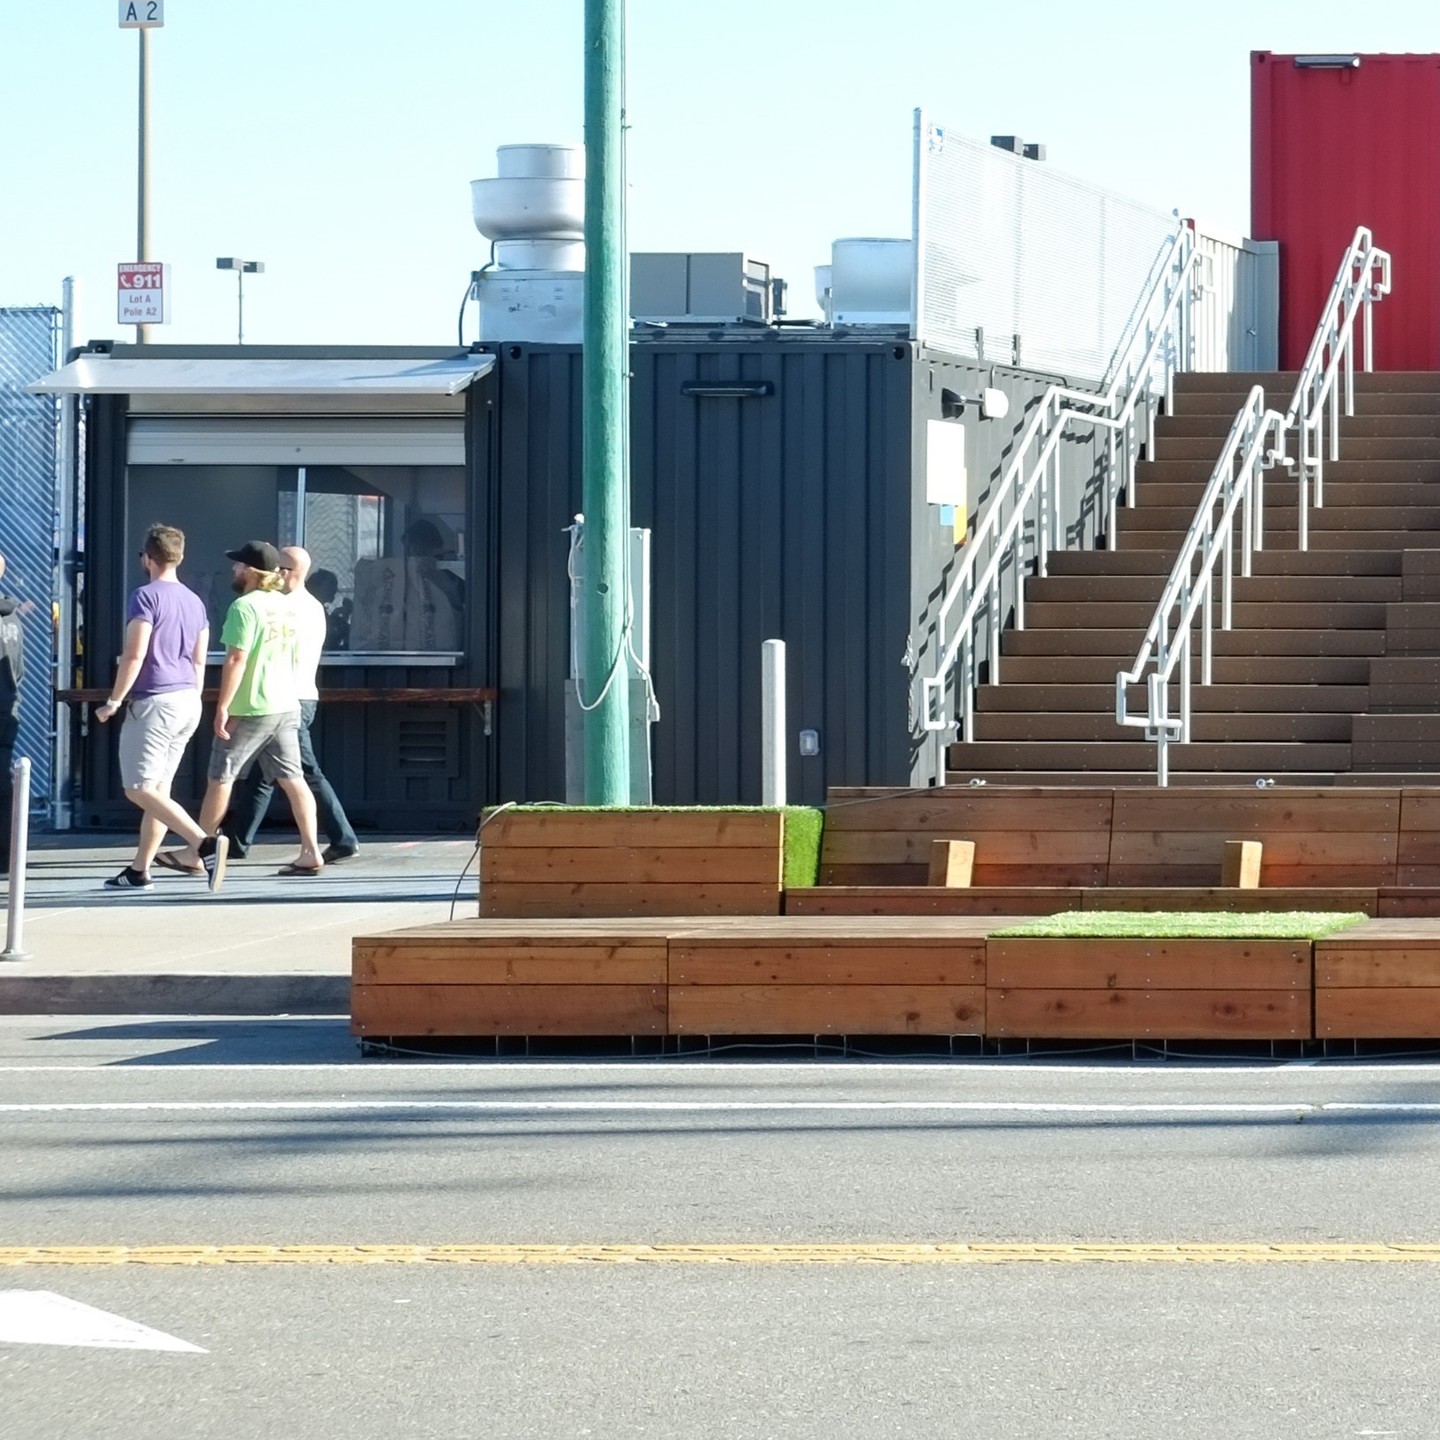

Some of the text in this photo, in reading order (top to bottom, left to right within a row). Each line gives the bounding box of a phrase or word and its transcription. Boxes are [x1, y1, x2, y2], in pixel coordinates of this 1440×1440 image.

[126, 0, 158, 21] A 2
[132, 274, 161, 288] 911
[129, 294, 151, 304] Lot A
[124, 306, 157, 316] Pole A2
